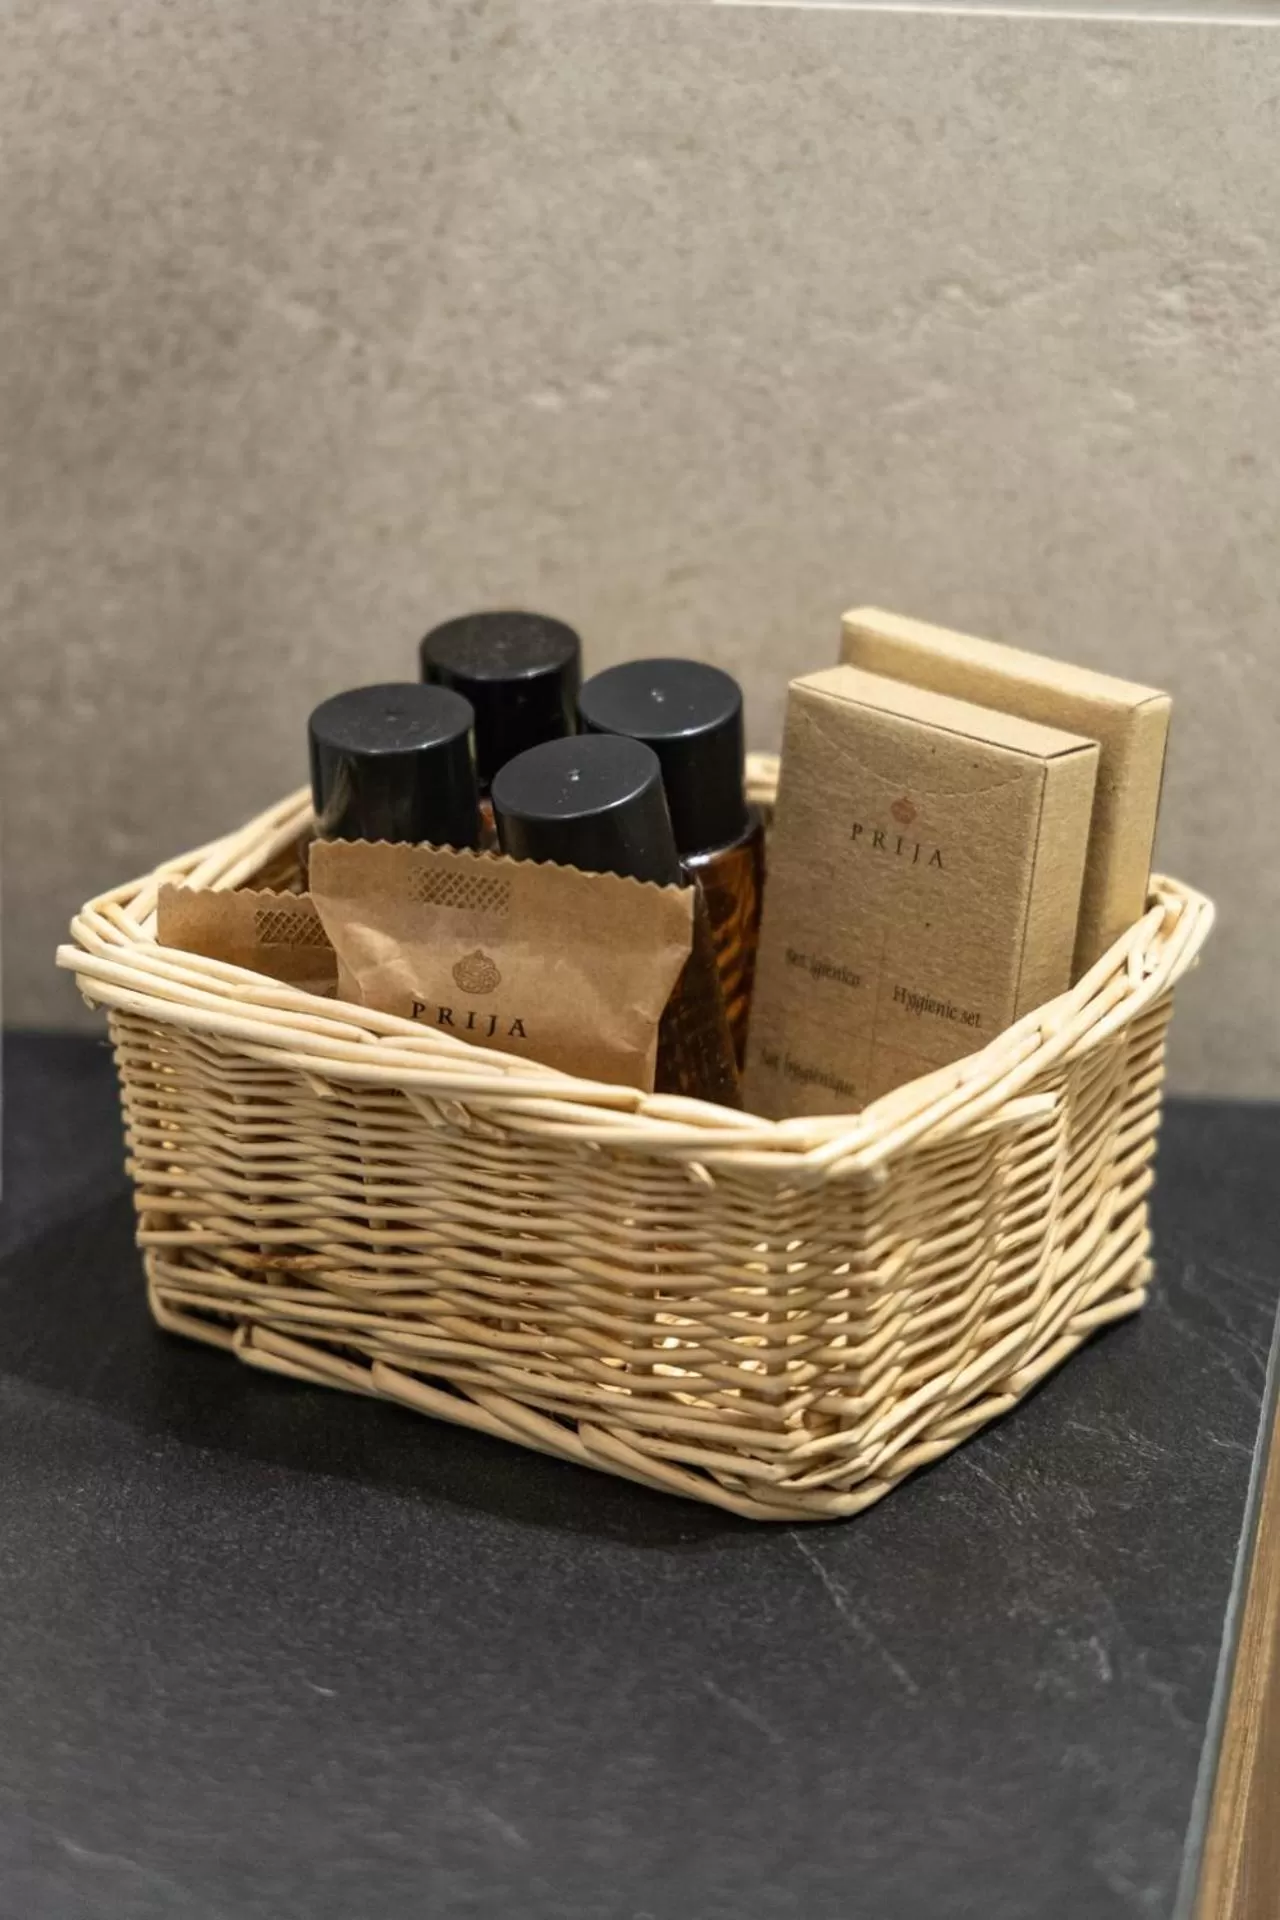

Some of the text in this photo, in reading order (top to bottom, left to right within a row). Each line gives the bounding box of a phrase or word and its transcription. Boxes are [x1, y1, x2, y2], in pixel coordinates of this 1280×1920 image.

[850, 821, 944, 870] PRIJA
[410, 1000, 528, 1038] PRIJA
[893, 984, 982, 1029] Hygienic set
